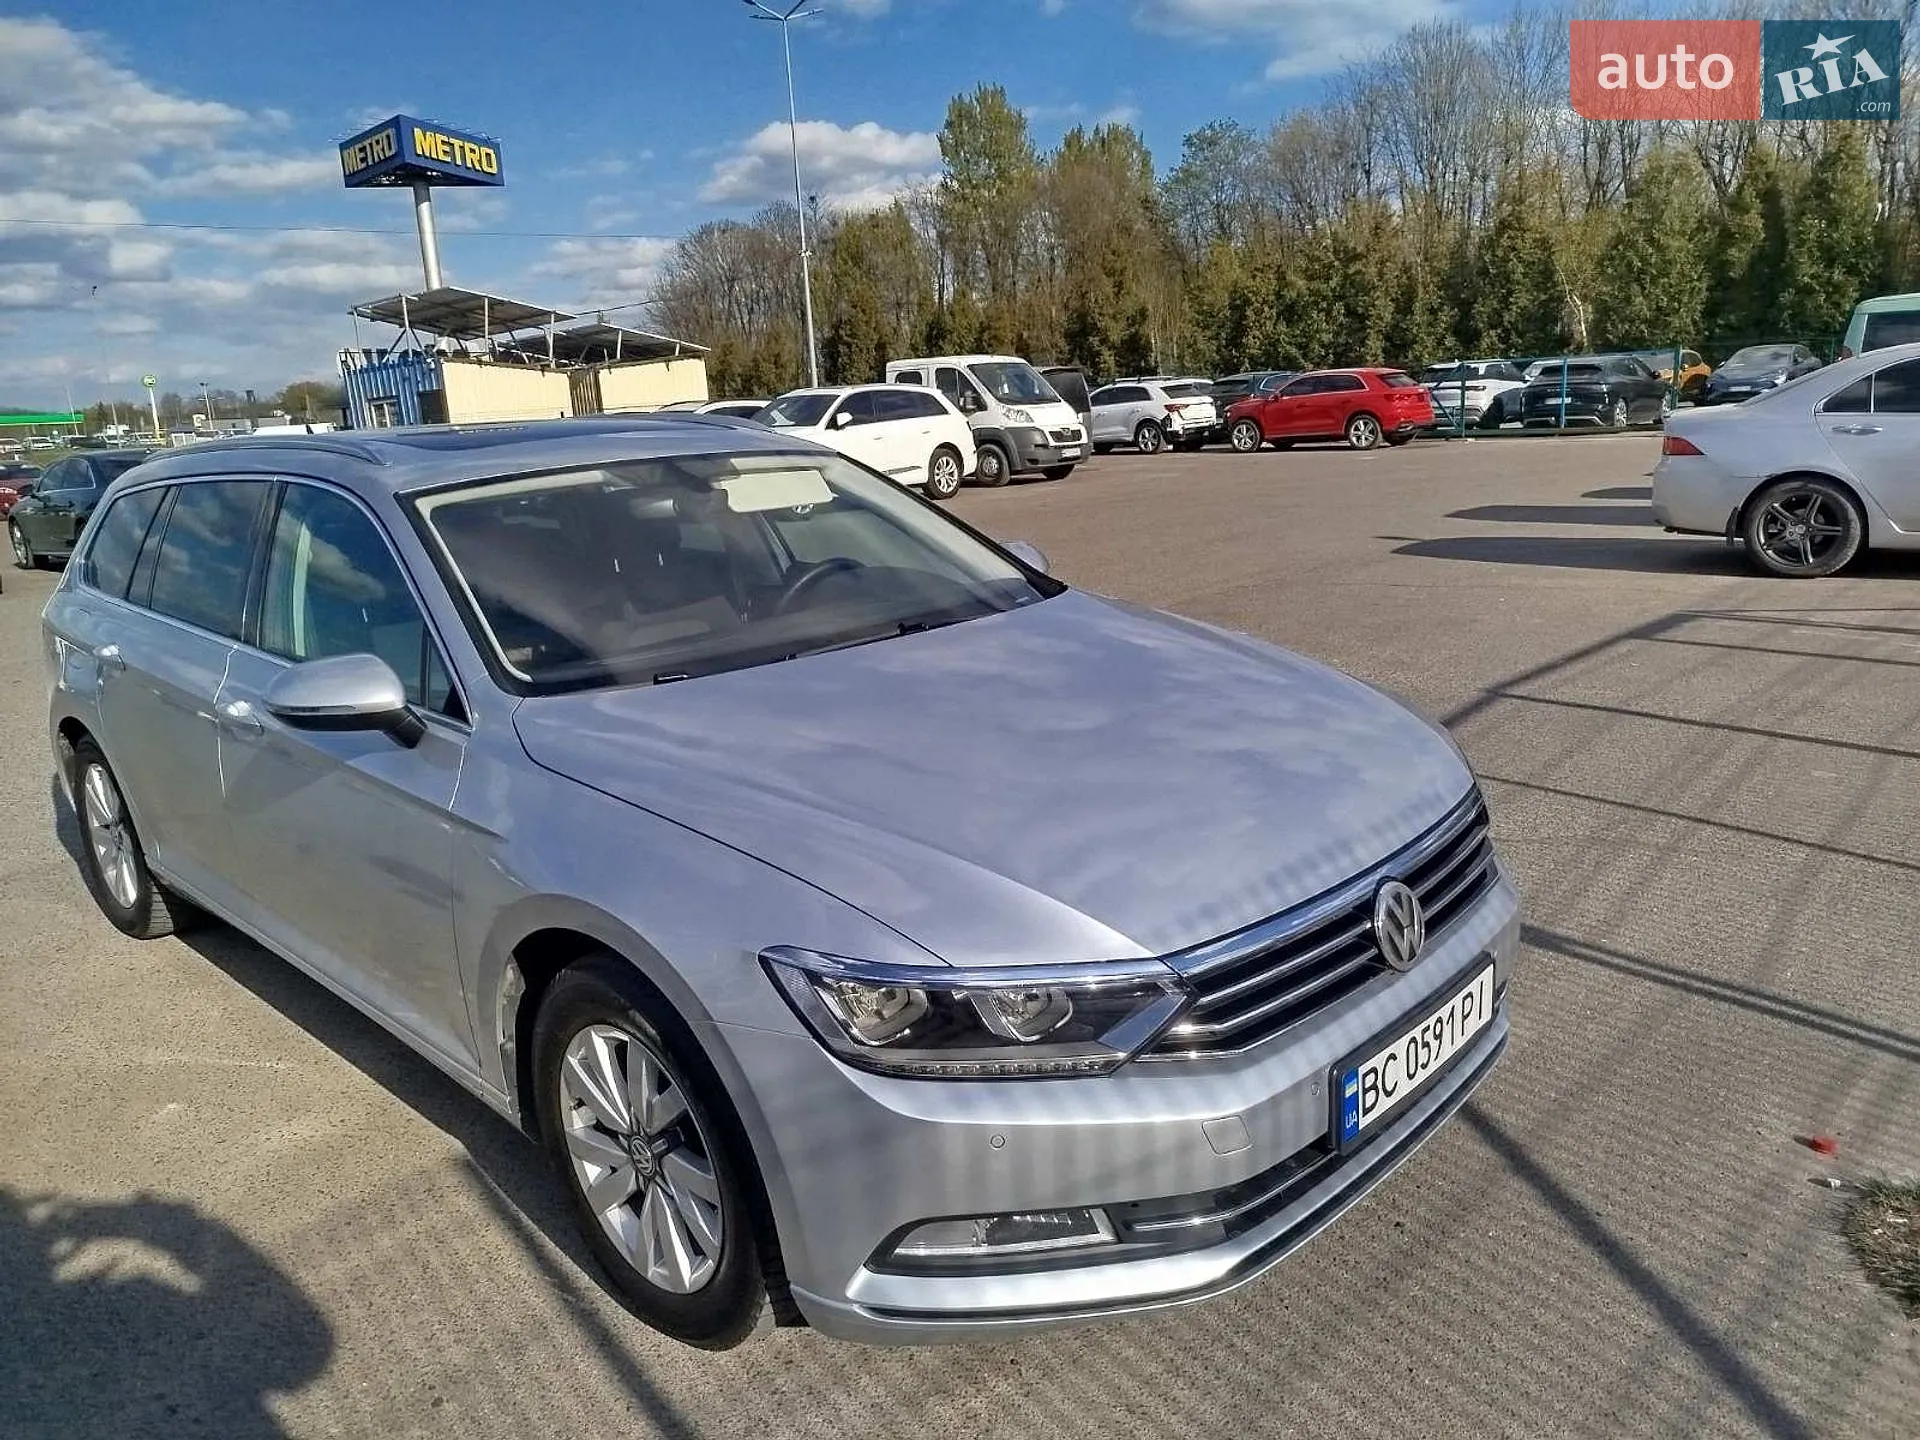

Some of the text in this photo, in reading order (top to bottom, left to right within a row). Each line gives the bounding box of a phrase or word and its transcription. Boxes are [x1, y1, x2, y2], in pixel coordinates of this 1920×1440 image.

[342, 127, 397, 174] METRO
[413, 127, 498, 175] METRO
[1345, 1110, 1358, 1129] UA
